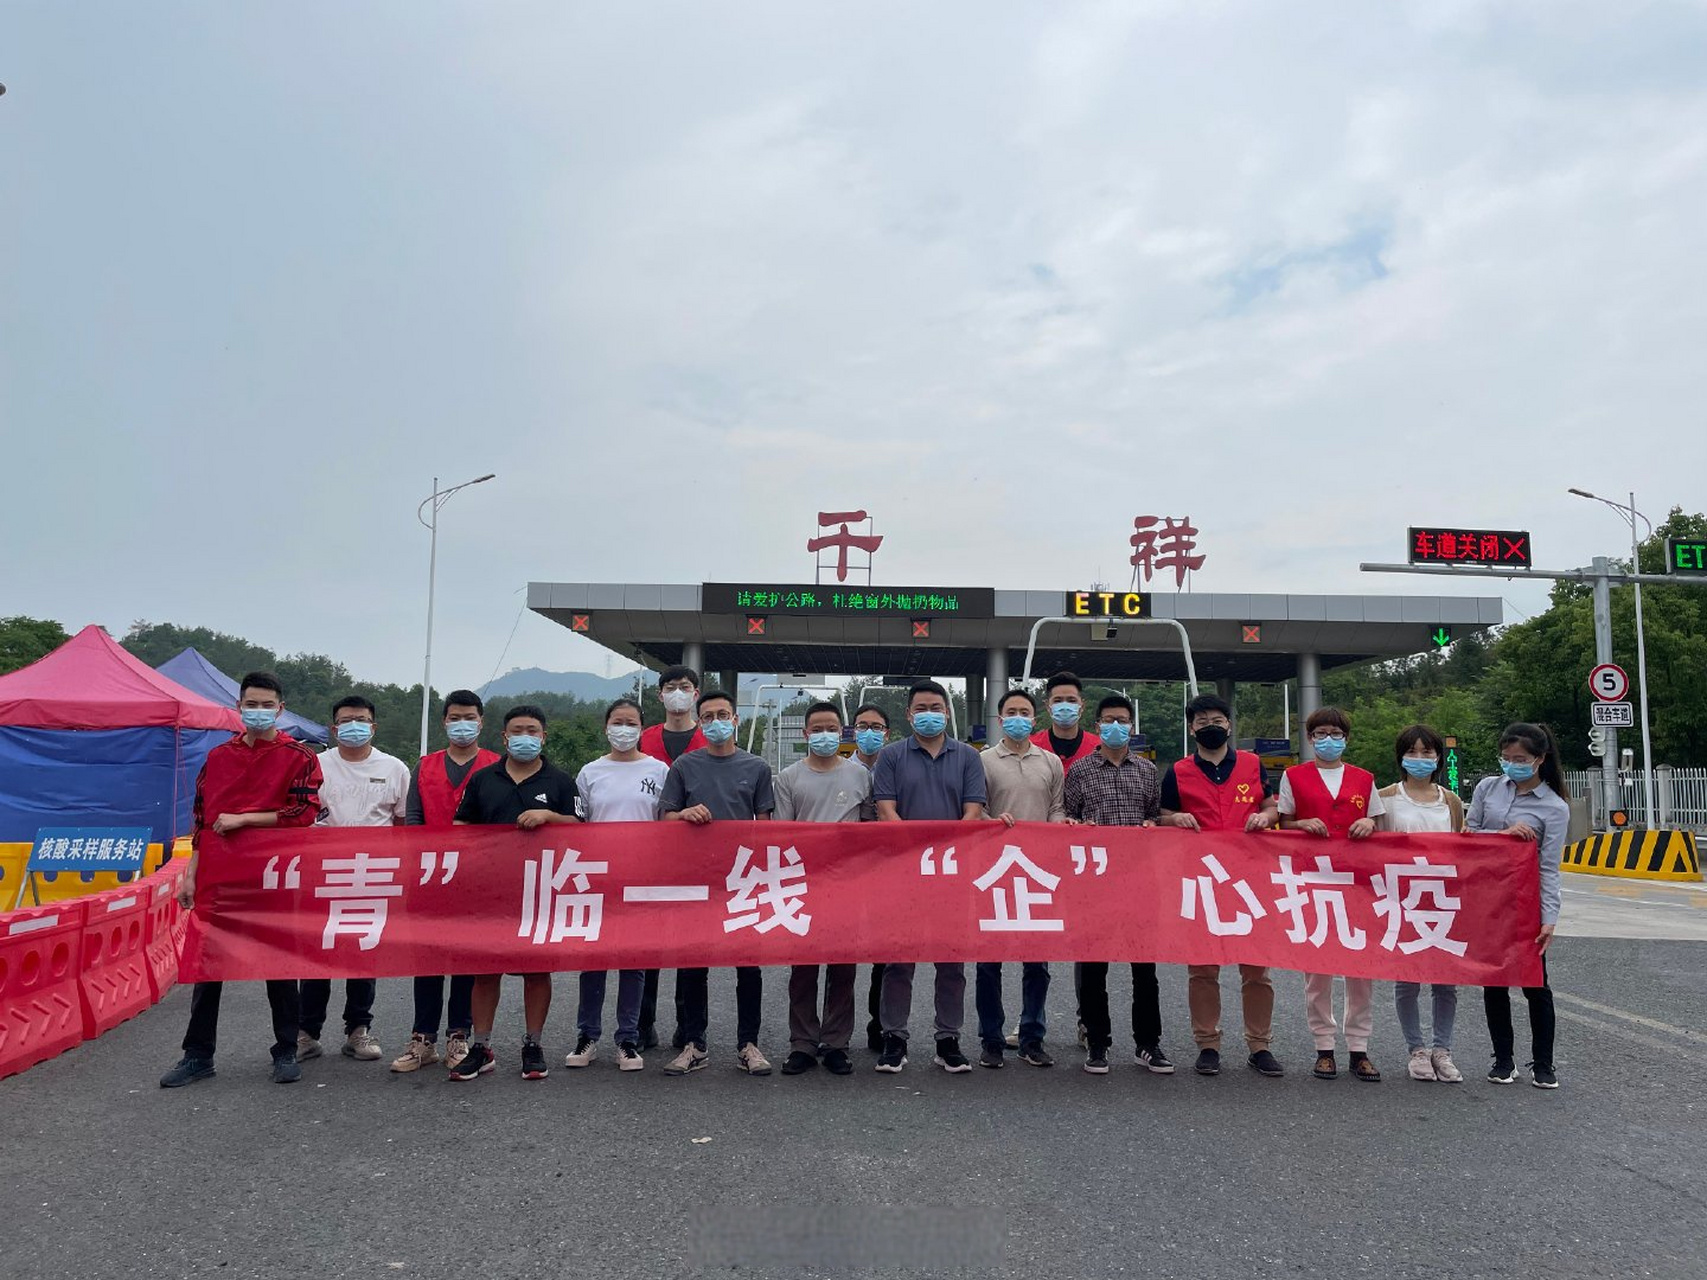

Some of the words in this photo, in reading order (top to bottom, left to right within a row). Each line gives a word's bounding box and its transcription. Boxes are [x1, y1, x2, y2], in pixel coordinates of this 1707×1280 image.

[1129, 515, 1206, 590] 祥
[1413, 530, 1501, 561] 车道关闭
[1074, 592, 1141, 616] ETC
[1602, 673, 1616, 691] 5
[34, 837, 144, 861] 核酸采样服务站
